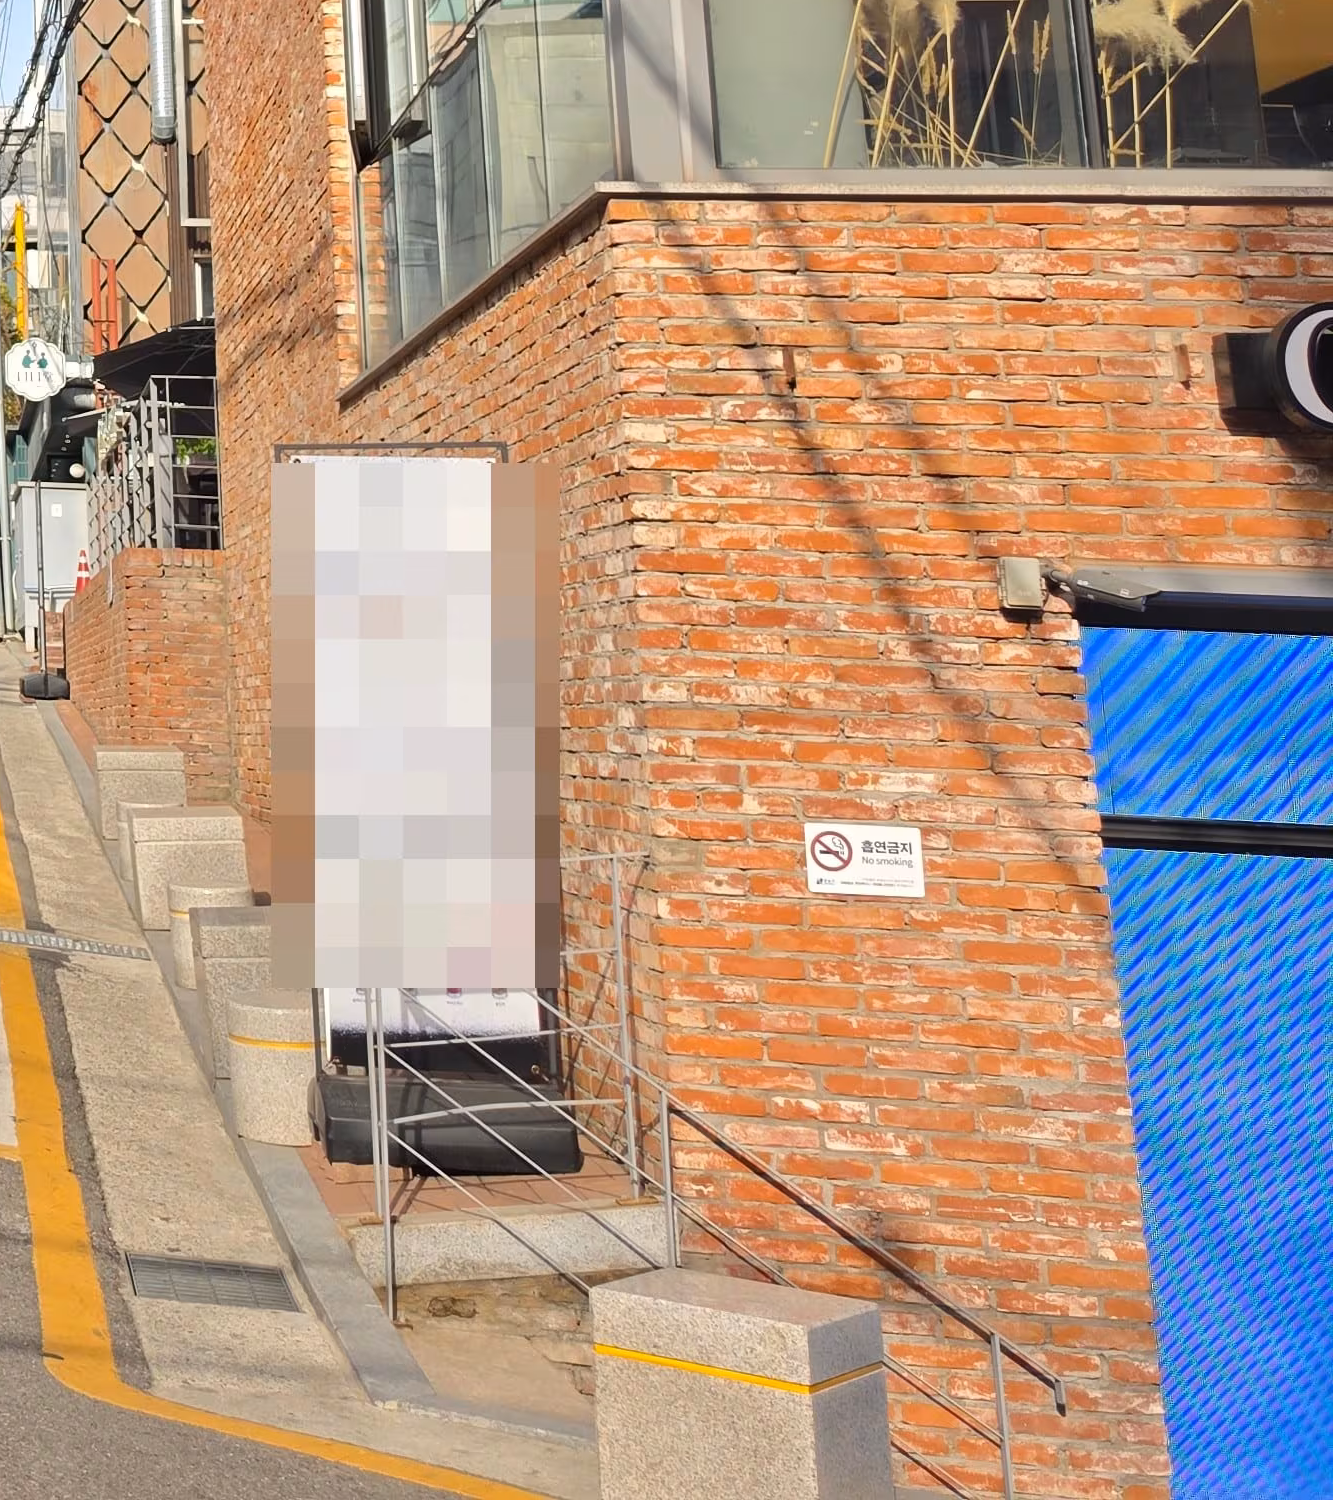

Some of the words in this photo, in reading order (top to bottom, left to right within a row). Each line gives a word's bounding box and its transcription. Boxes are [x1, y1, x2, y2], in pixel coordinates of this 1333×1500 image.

[861, 840, 913, 855] 흡연금지
[862, 856, 875, 865] No
[876, 857, 914, 869] smoking
